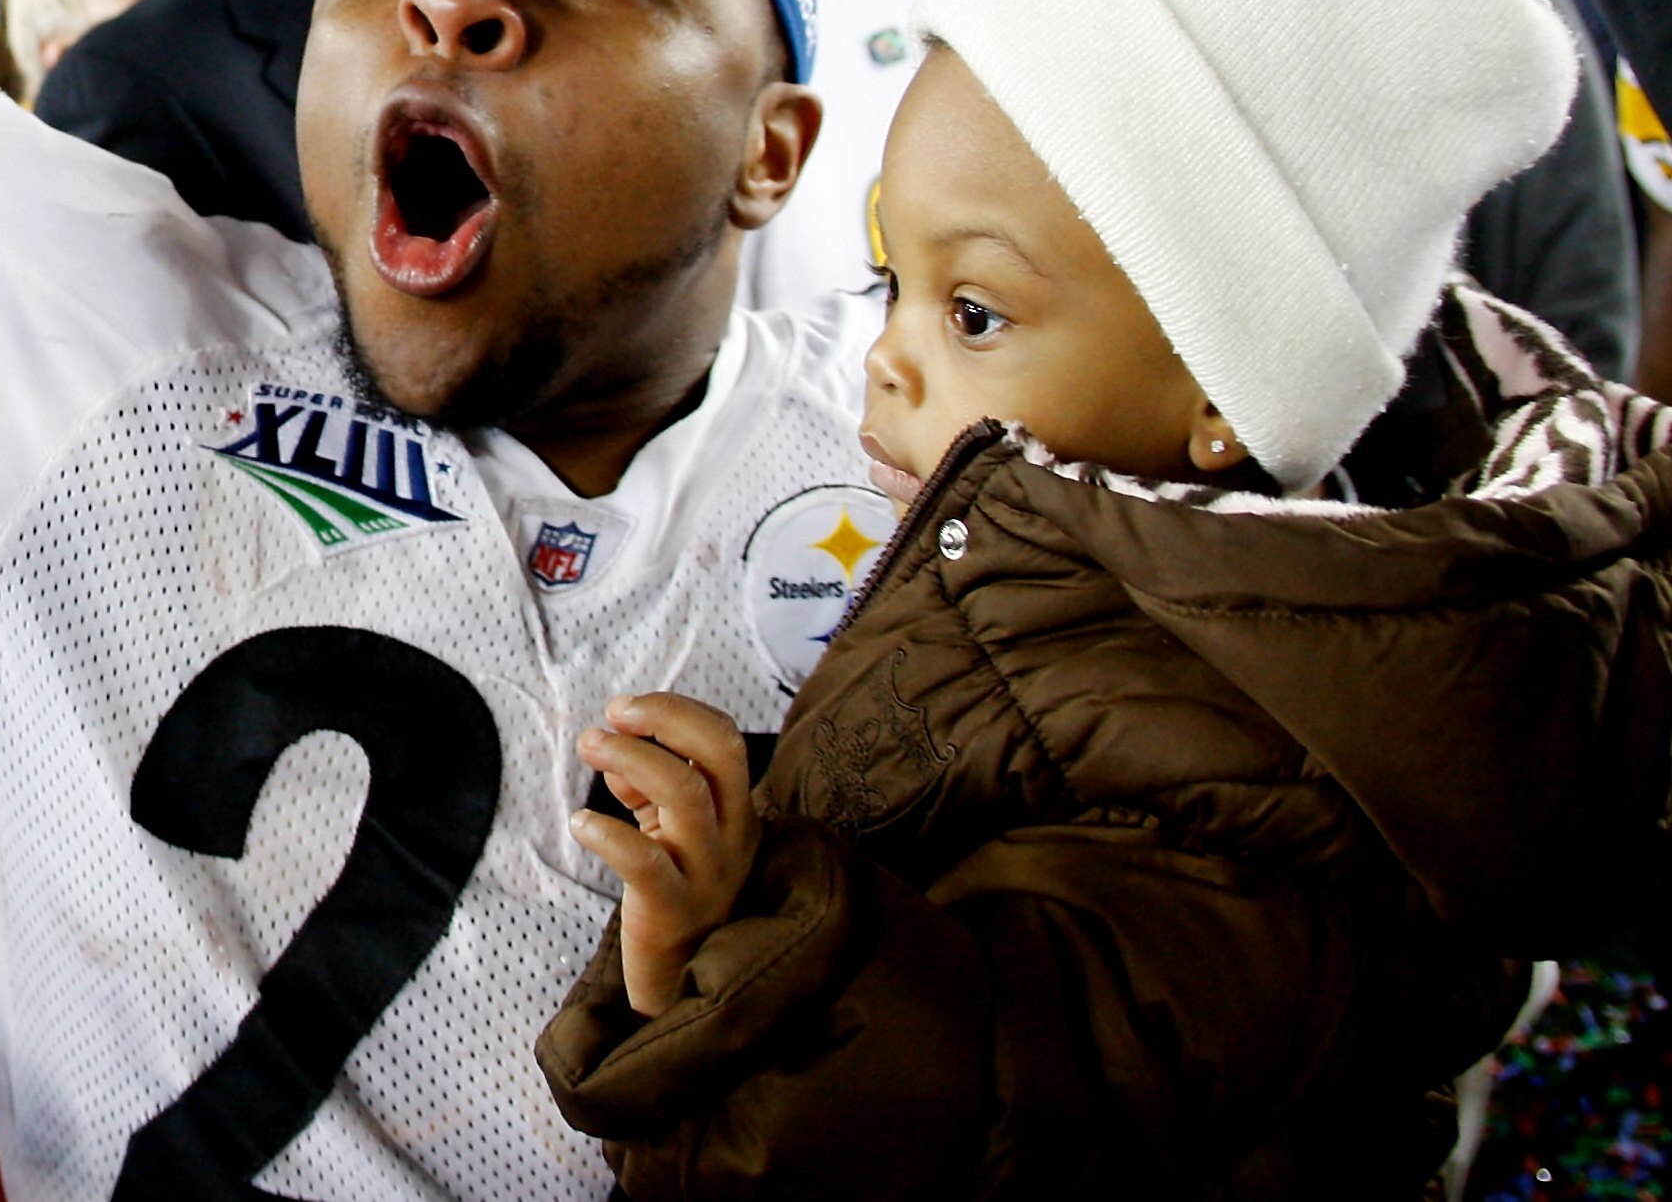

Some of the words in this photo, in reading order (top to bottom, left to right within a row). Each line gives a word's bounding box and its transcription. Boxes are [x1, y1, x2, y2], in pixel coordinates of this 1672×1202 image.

[254, 383, 345, 410] SUPER
[203, 402, 456, 516] XLIII
[532, 542, 584, 582] NFL
[768, 576, 845, 600] Steelers
